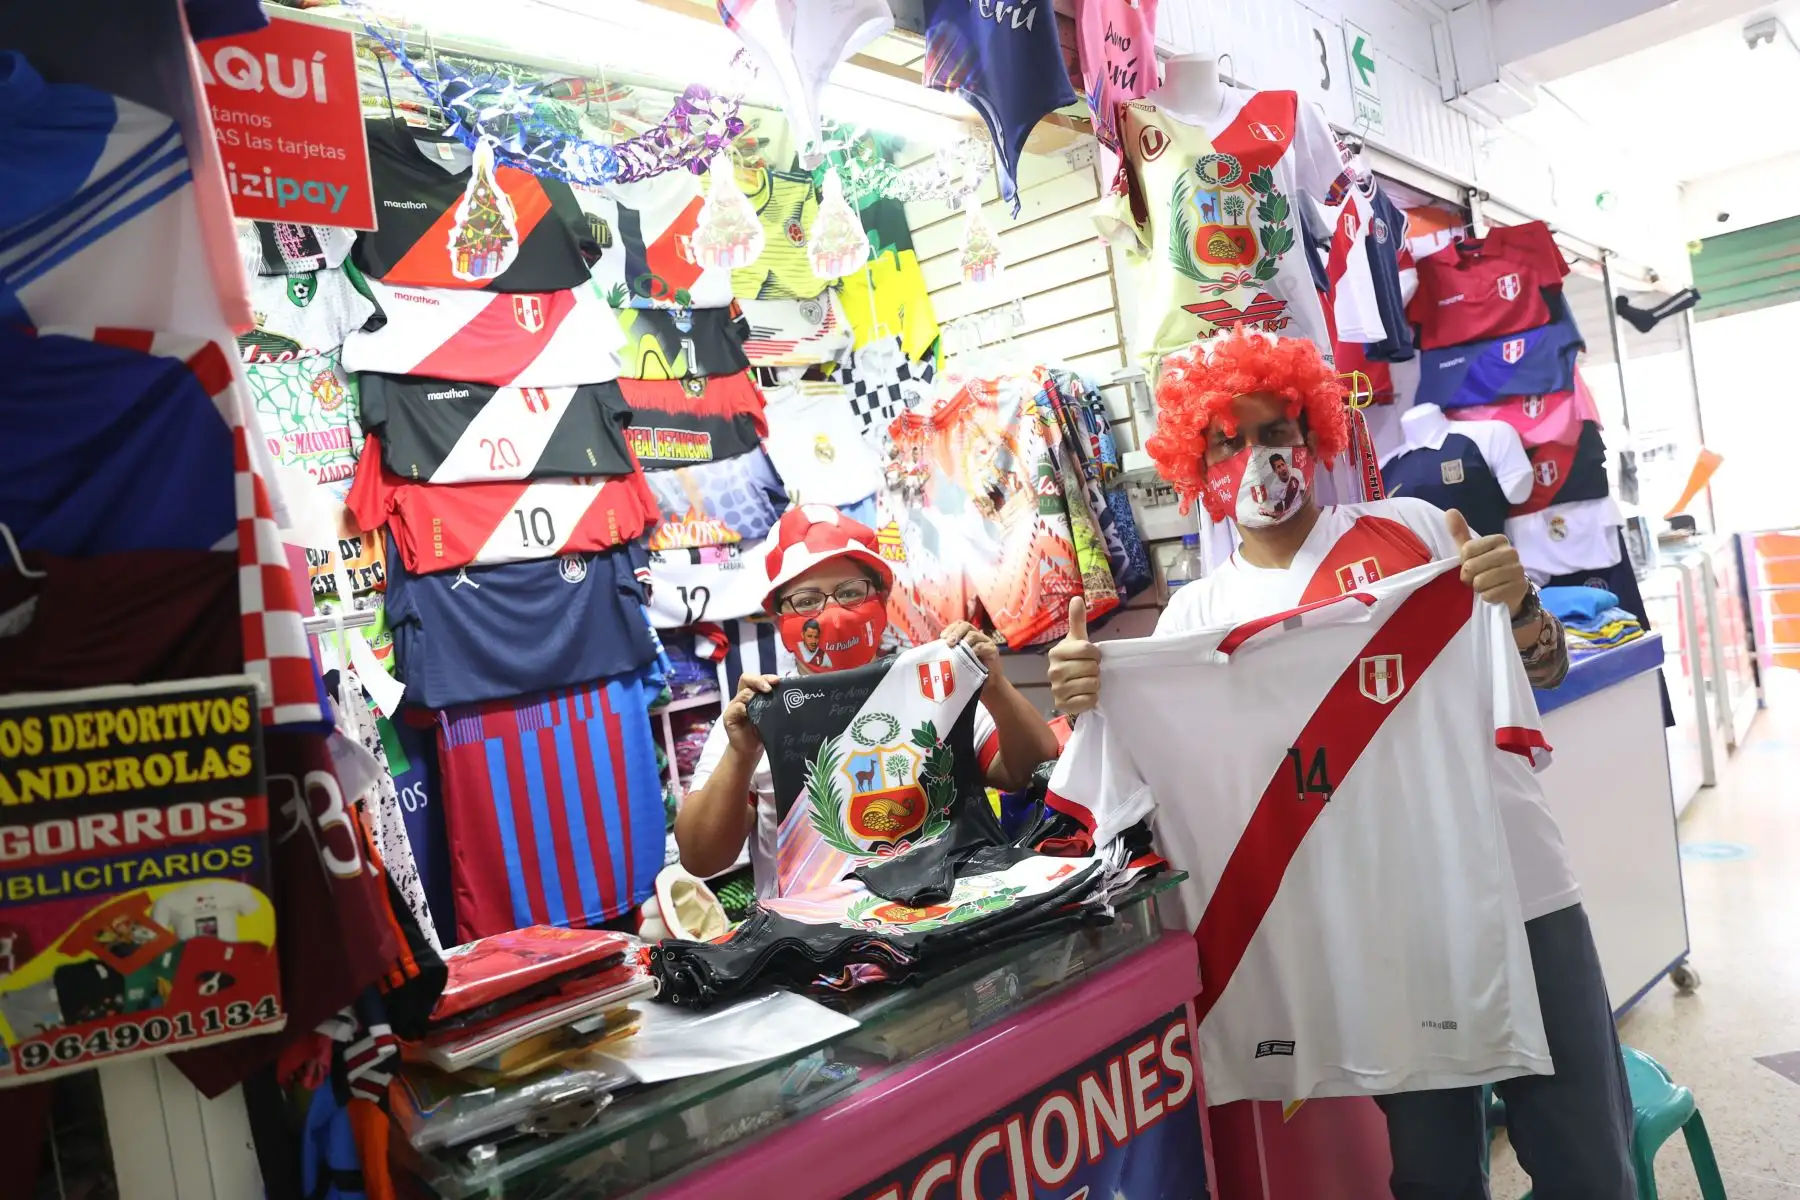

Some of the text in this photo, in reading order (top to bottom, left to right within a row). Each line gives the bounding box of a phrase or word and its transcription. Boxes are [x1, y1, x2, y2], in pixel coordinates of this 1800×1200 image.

[970, 0, 1037, 32] erú
[1105, 20, 1131, 52] Amo
[246, 128, 273, 151] las
[277, 137, 347, 161] tarjetas
[227, 162, 349, 213] izipay
[383, 199, 427, 210] marathon
[394, 291, 440, 306] marathon
[427, 388, 469, 401] marathon
[480, 437, 521, 471] 20
[514, 507, 556, 547] 10
[661, 520, 725, 547] SPORT
[1346, 571, 1376, 589] FPF
[676, 586, 711, 625] 12
[825, 642, 835, 650] La
[923, 672, 950, 686] FPF
[49, 696, 250, 753] DEPORTIVOS
[1287, 746, 1333, 802] 14
[0, 797, 248, 862] GORROS
[0, 845, 254, 902] BLICITARIOS
[21, 996, 279, 1070] 964901134
[868, 1024, 1194, 1200] CCIONES
